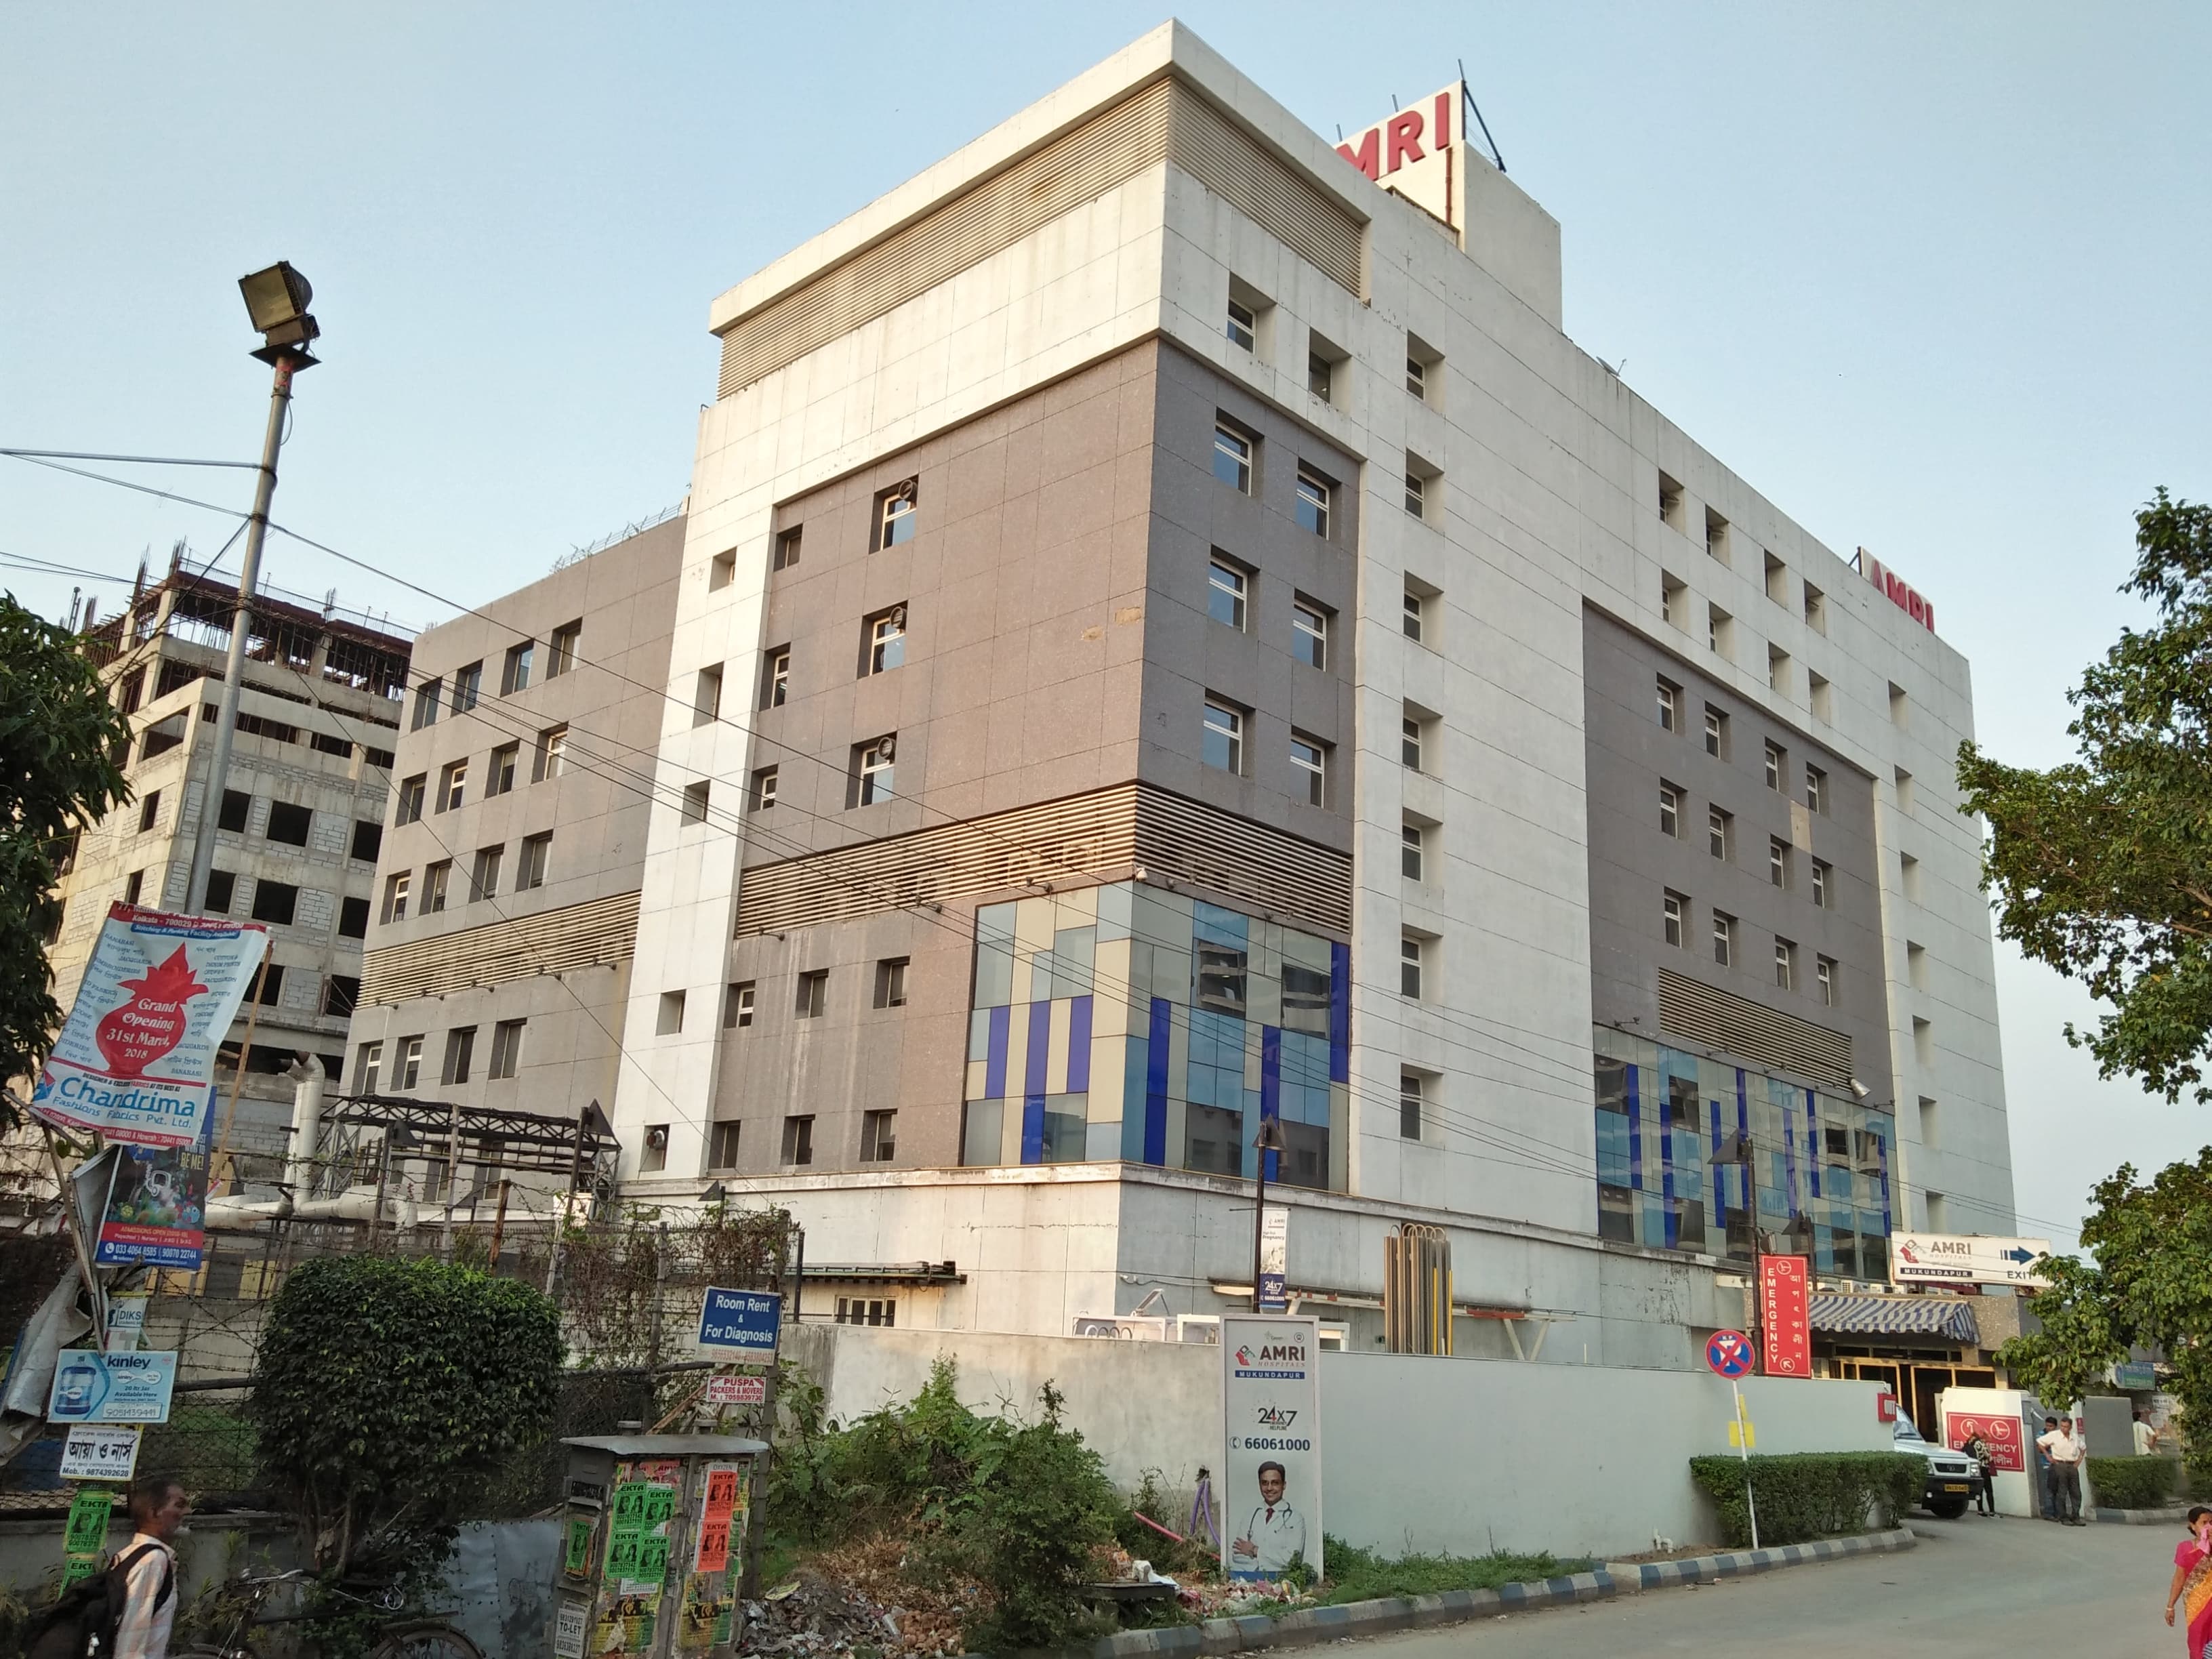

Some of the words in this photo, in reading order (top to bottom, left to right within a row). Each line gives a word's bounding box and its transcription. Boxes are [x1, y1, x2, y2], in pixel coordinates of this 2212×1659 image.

[132, 915, 158, 924] Kolkata
[138, 998, 177, 1014] Grand
[122, 1012, 175, 1031] Opening
[106, 1028, 135, 1044] 31st
[124, 1048, 148, 1059] 2018
[60, 1076, 195, 1118] Chandrima
[53, 1097, 101, 1117] Fashions
[107, 1109, 140, 1122] Fabrics
[146, 1113, 167, 1126] Pvt.
[171, 1117, 191, 1128] Ltd.
[180, 1154, 190, 1168] BE
[190, 1155, 204, 1170] ME!
[115, 1244, 127, 1254] 033
[180, 1250, 197, 1259] 22744
[1931, 1241, 1971, 1255] AMRI
[1904, 1268, 1969, 1277] MUKUNDAPUR
[2007, 1271, 2032, 1280] EXIT
[716, 1294, 745, 1310] Room
[747, 1298, 770, 1313] Rent
[119, 1311, 142, 1321] DIKS
[737, 1313, 743, 1323] &
[1767, 1267, 1778, 1364] EMERGENCY
[705, 1324, 722, 1338] For
[724, 1325, 773, 1344] Diagnosis
[1259, 1345, 1306, 1361] AMRI
[107, 1355, 151, 1370] kinley
[724, 1378, 754, 1387] PUSPA
[710, 1386, 735, 1394] PACKERS
[742, 1387, 763, 1395] MOVERS
[69, 1439, 96, 1460] আয়া
[99, 1443, 108, 1459] ও
[111, 1437, 138, 1462] নার্স
[1245, 1437, 1311, 1451] 66061000
[1953, 1440, 2018, 1453] EMENCY
[85, 1469, 129, 1477] 9874392628
[70, 1562, 93, 1570] EKT
